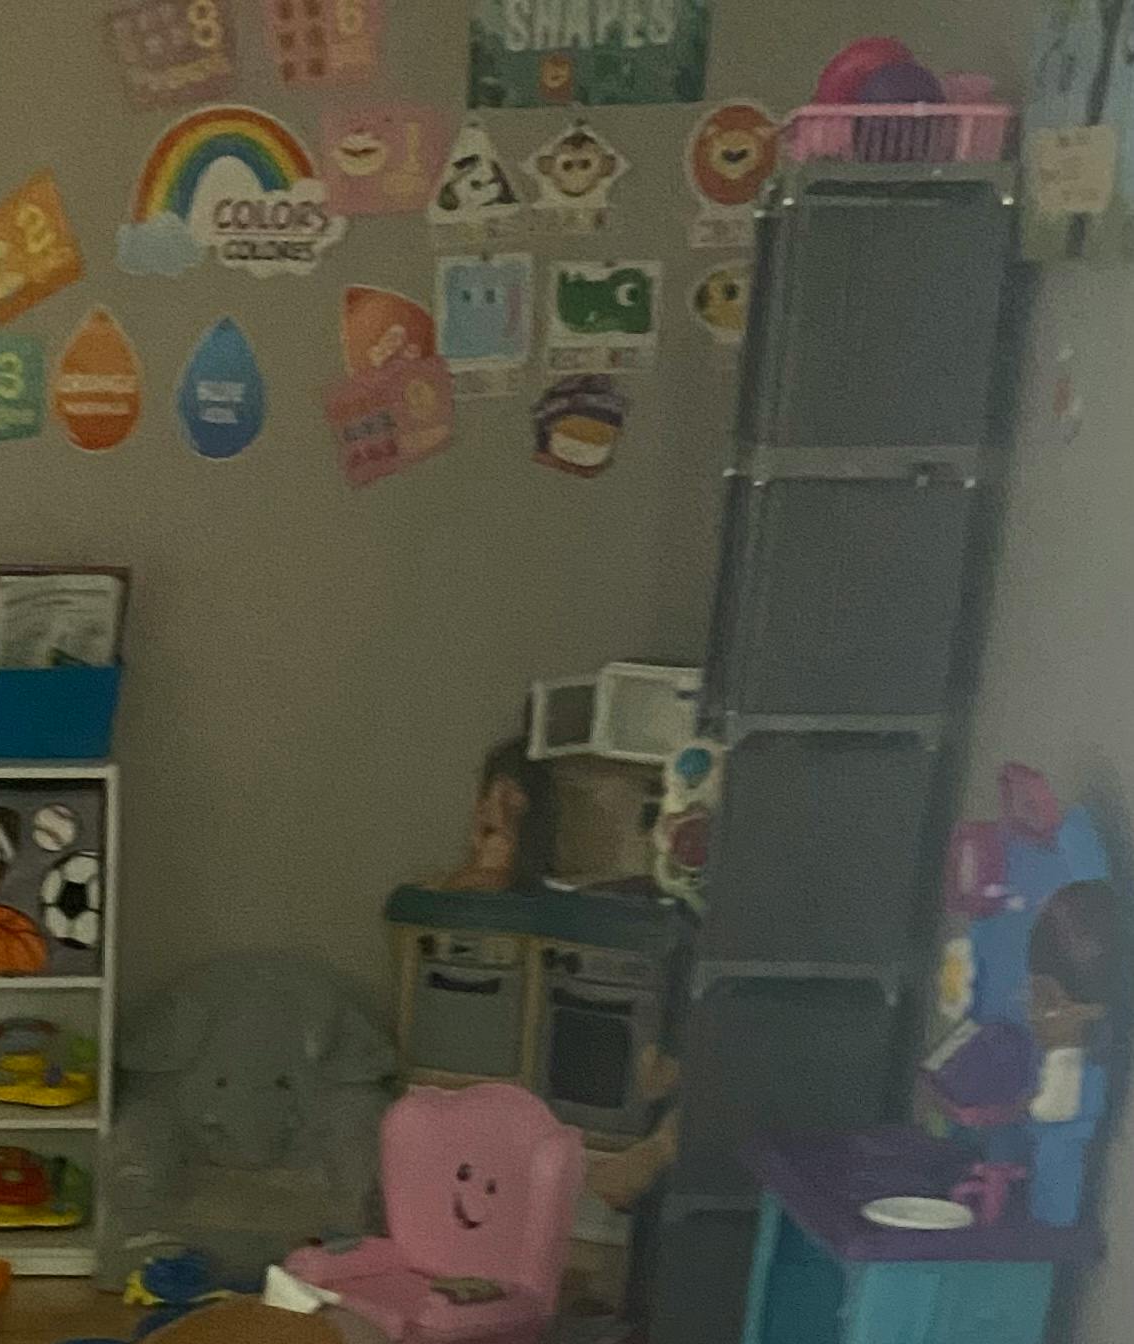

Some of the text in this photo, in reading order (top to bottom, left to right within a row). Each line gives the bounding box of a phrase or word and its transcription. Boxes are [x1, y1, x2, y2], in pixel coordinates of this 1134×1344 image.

[188, 0, 223, 48] 8
[504, 0, 675, 51] SHAPES
[16, 202, 57, 255] 2
[213, 198, 330, 231] COLORS
